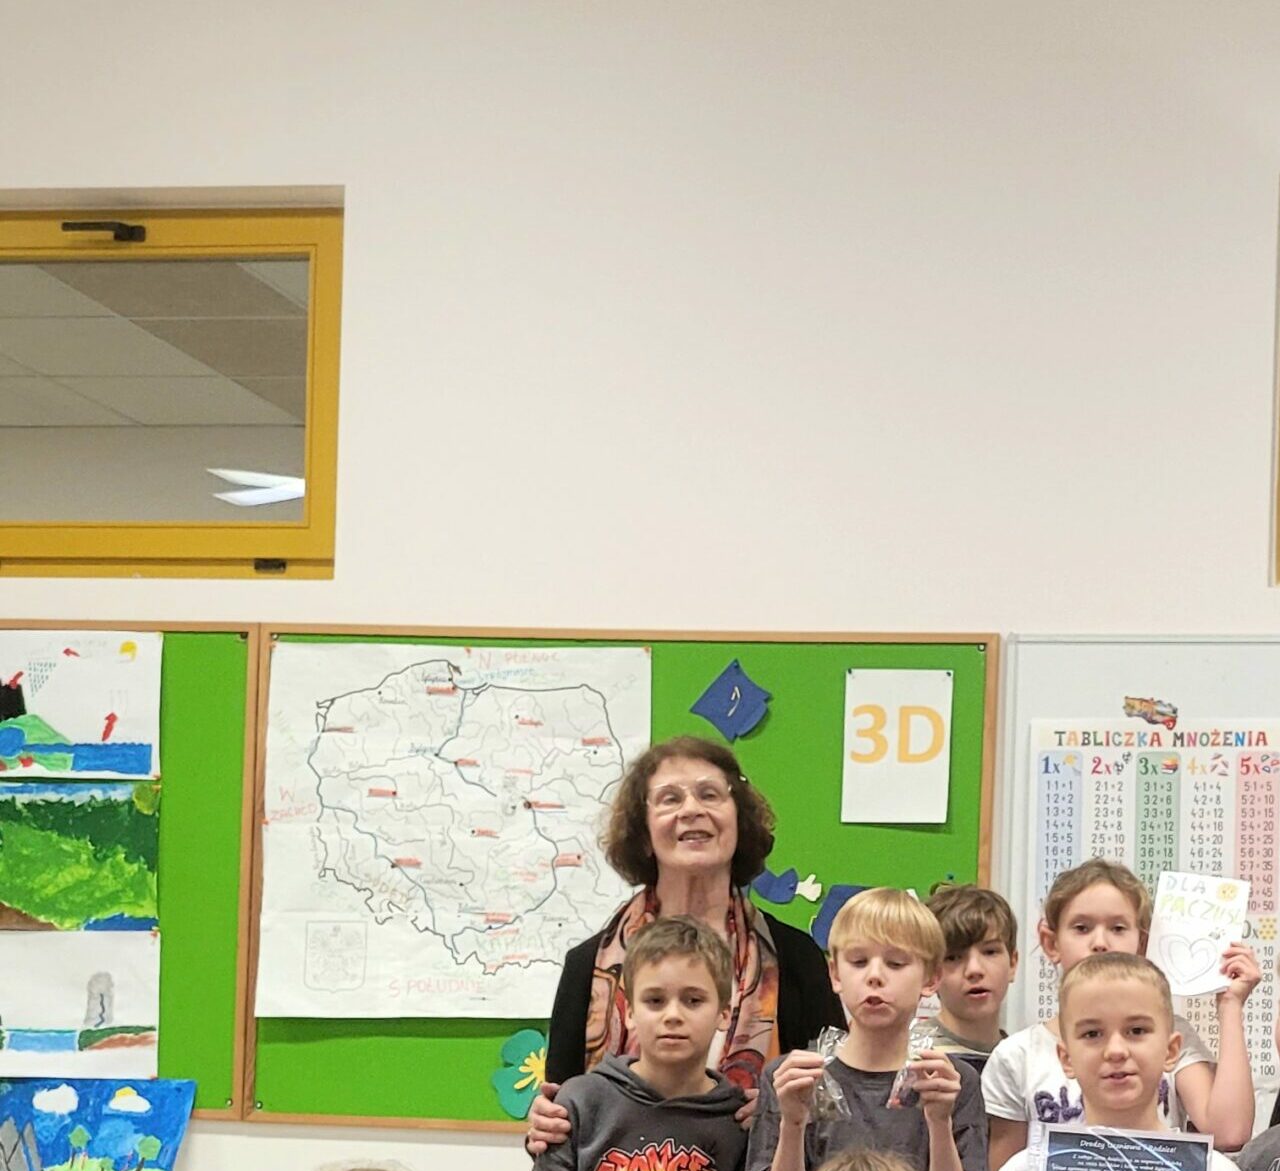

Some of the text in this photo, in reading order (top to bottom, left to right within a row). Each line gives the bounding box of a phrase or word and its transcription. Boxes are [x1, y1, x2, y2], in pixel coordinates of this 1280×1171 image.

[850, 703, 945, 764] 3D
[1054, 729, 1268, 747] TABLICZKA MNOŻENIA
